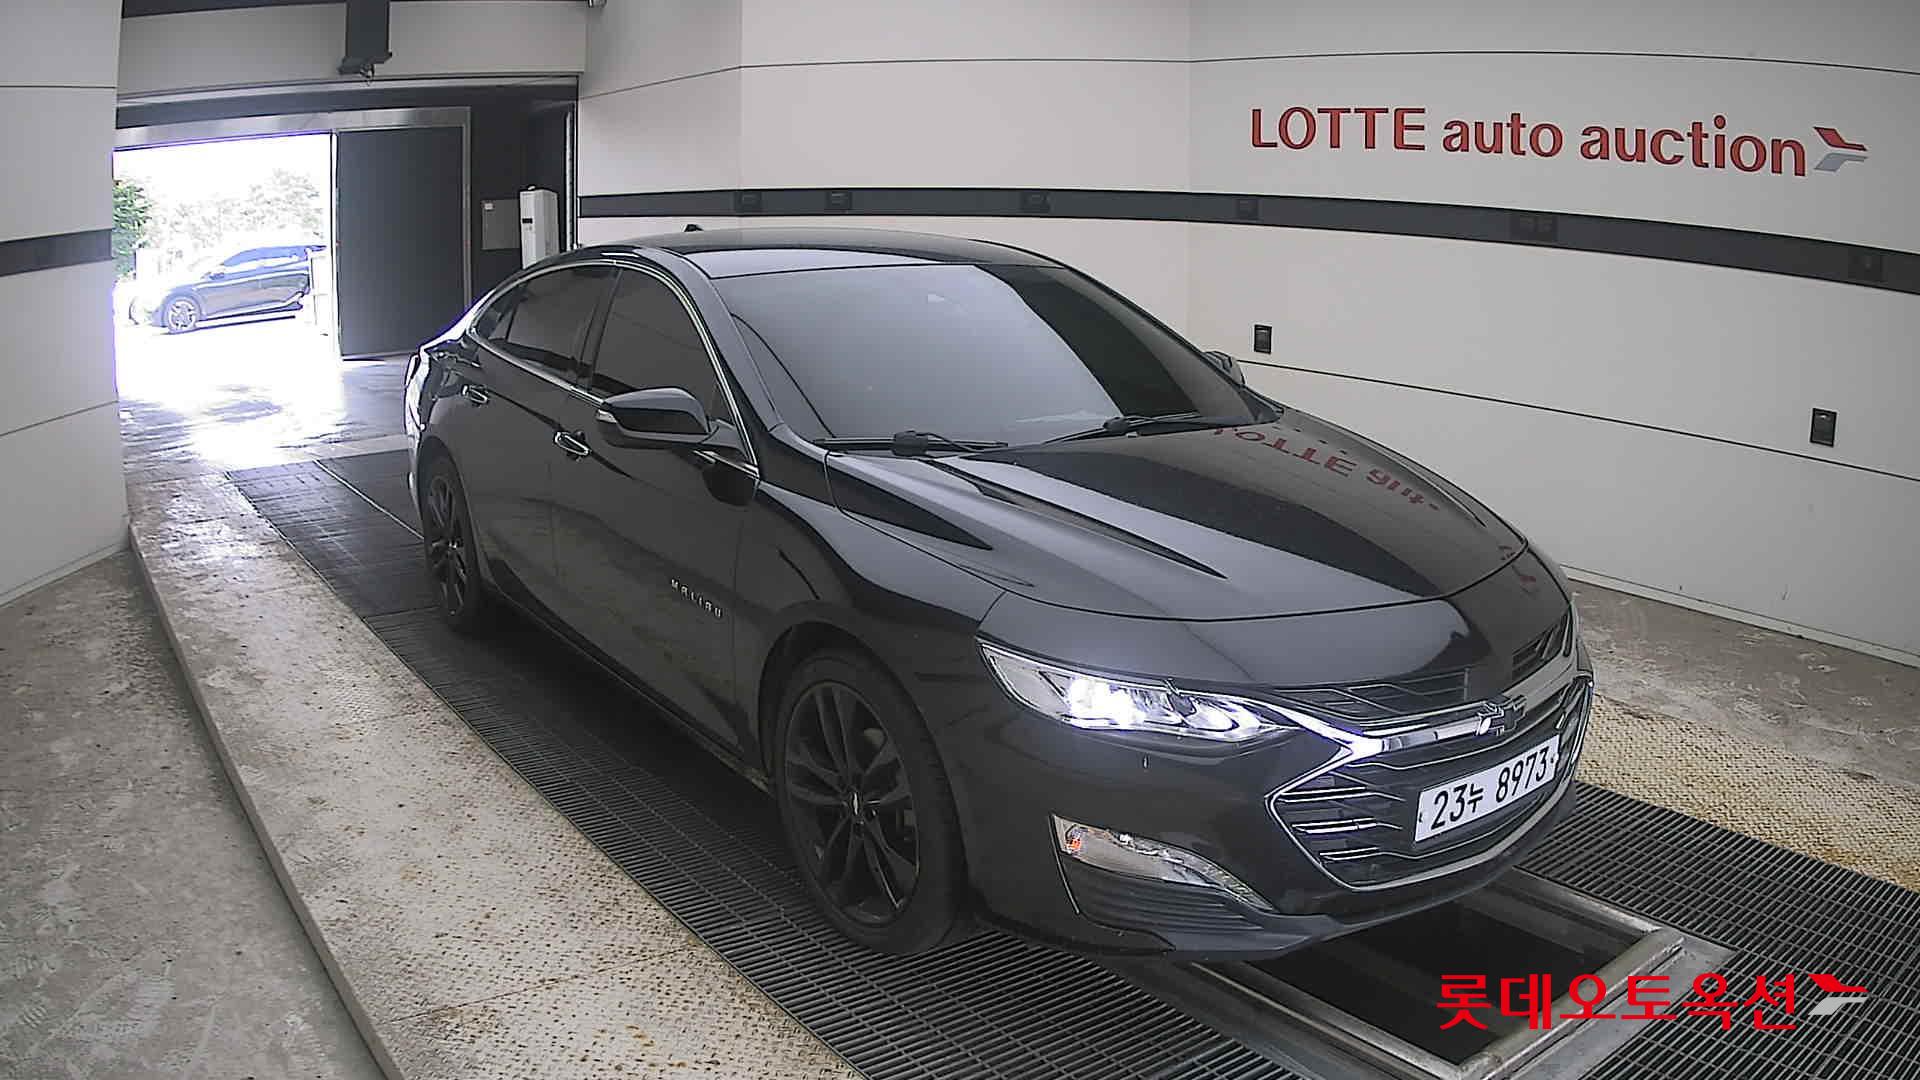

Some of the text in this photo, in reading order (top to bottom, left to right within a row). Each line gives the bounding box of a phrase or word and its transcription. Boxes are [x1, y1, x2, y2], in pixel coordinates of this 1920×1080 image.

[1251, 107, 1806, 177] LOTTE auto auction
[1430, 745, 1550, 831] 23누 8973
